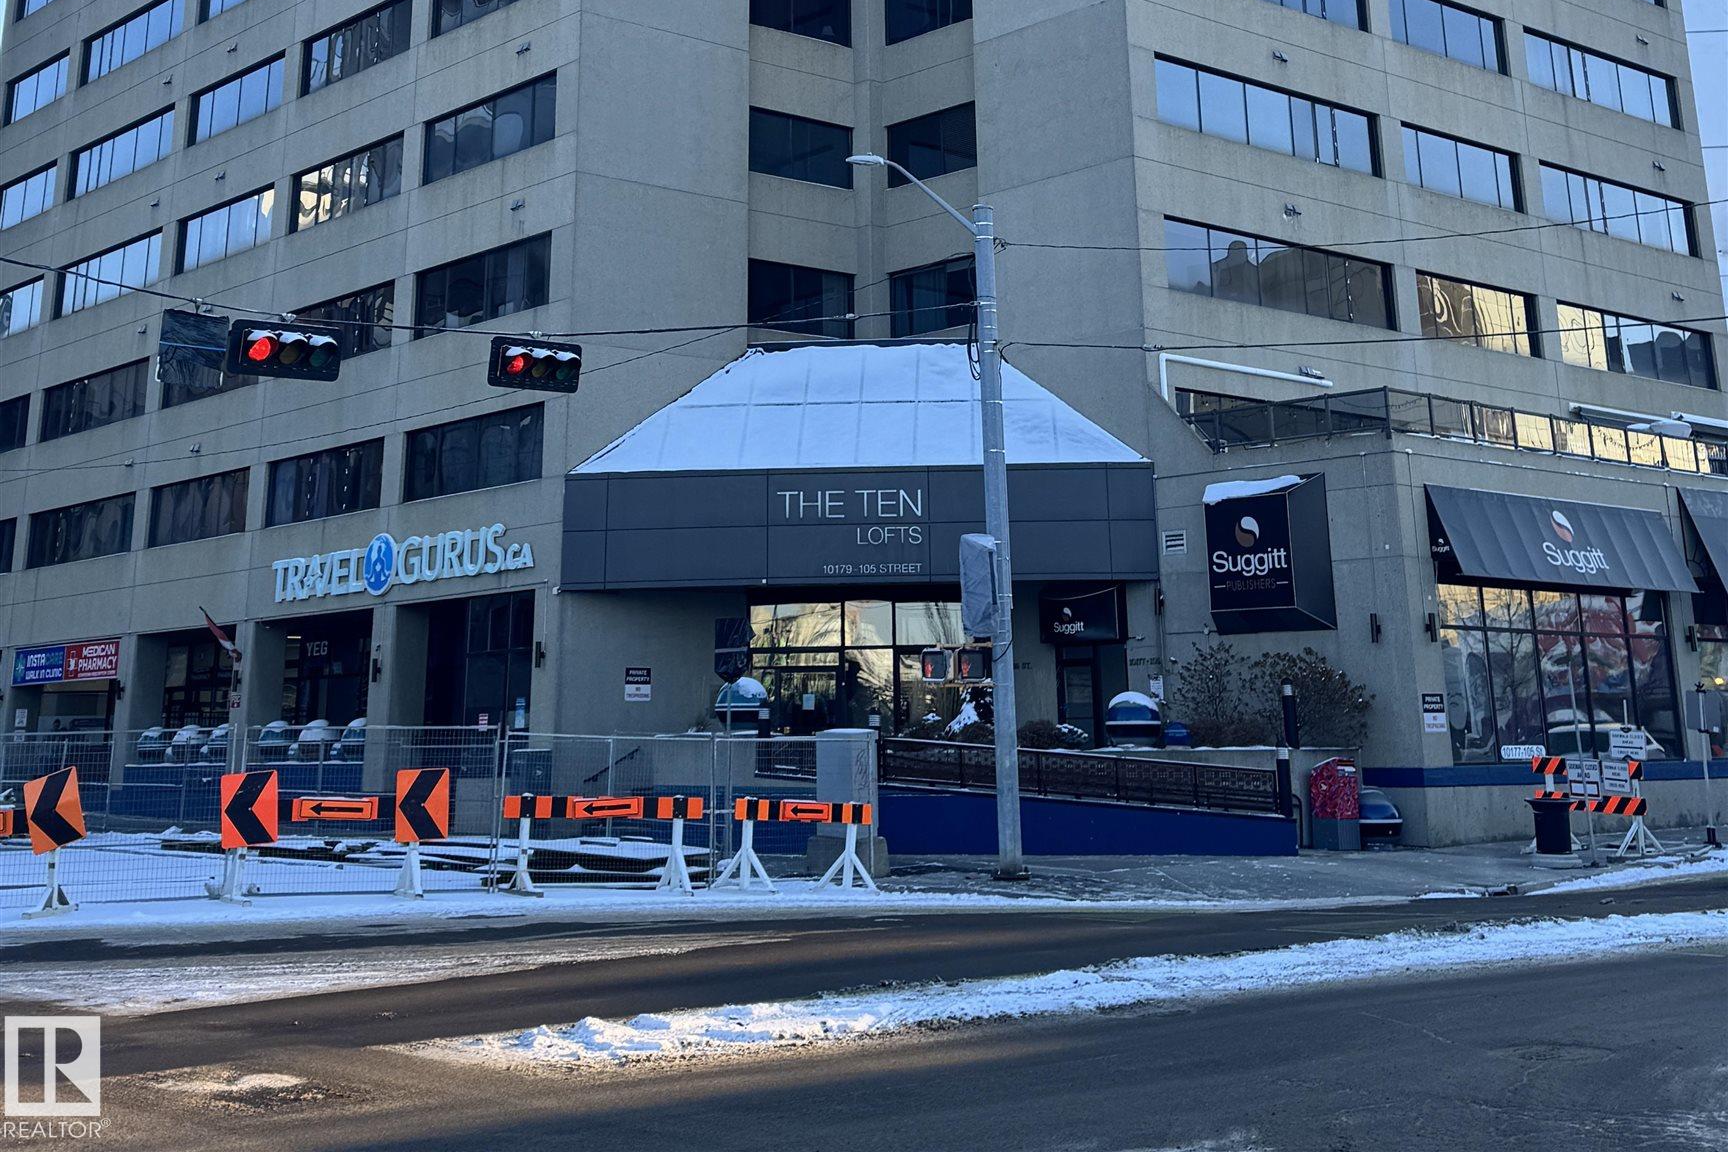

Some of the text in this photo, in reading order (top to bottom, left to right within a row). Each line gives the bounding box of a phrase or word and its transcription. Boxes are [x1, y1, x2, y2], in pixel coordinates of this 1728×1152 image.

[776, 489, 922, 518] THE TEN
[857, 526, 922, 545] LOFTS
[1212, 547, 1288, 576] Suggitt
[1543, 542, 1610, 574] Suggitt
[271, 548, 365, 603] TRAVEL
[879, 563, 922, 573] STREET
[1226, 578, 1276, 591] PUBLISHERS
[1053, 620, 1085, 634] Suggitt
[306, 641, 328, 657] YEG
[78, 656, 117, 672] PHARMACY
